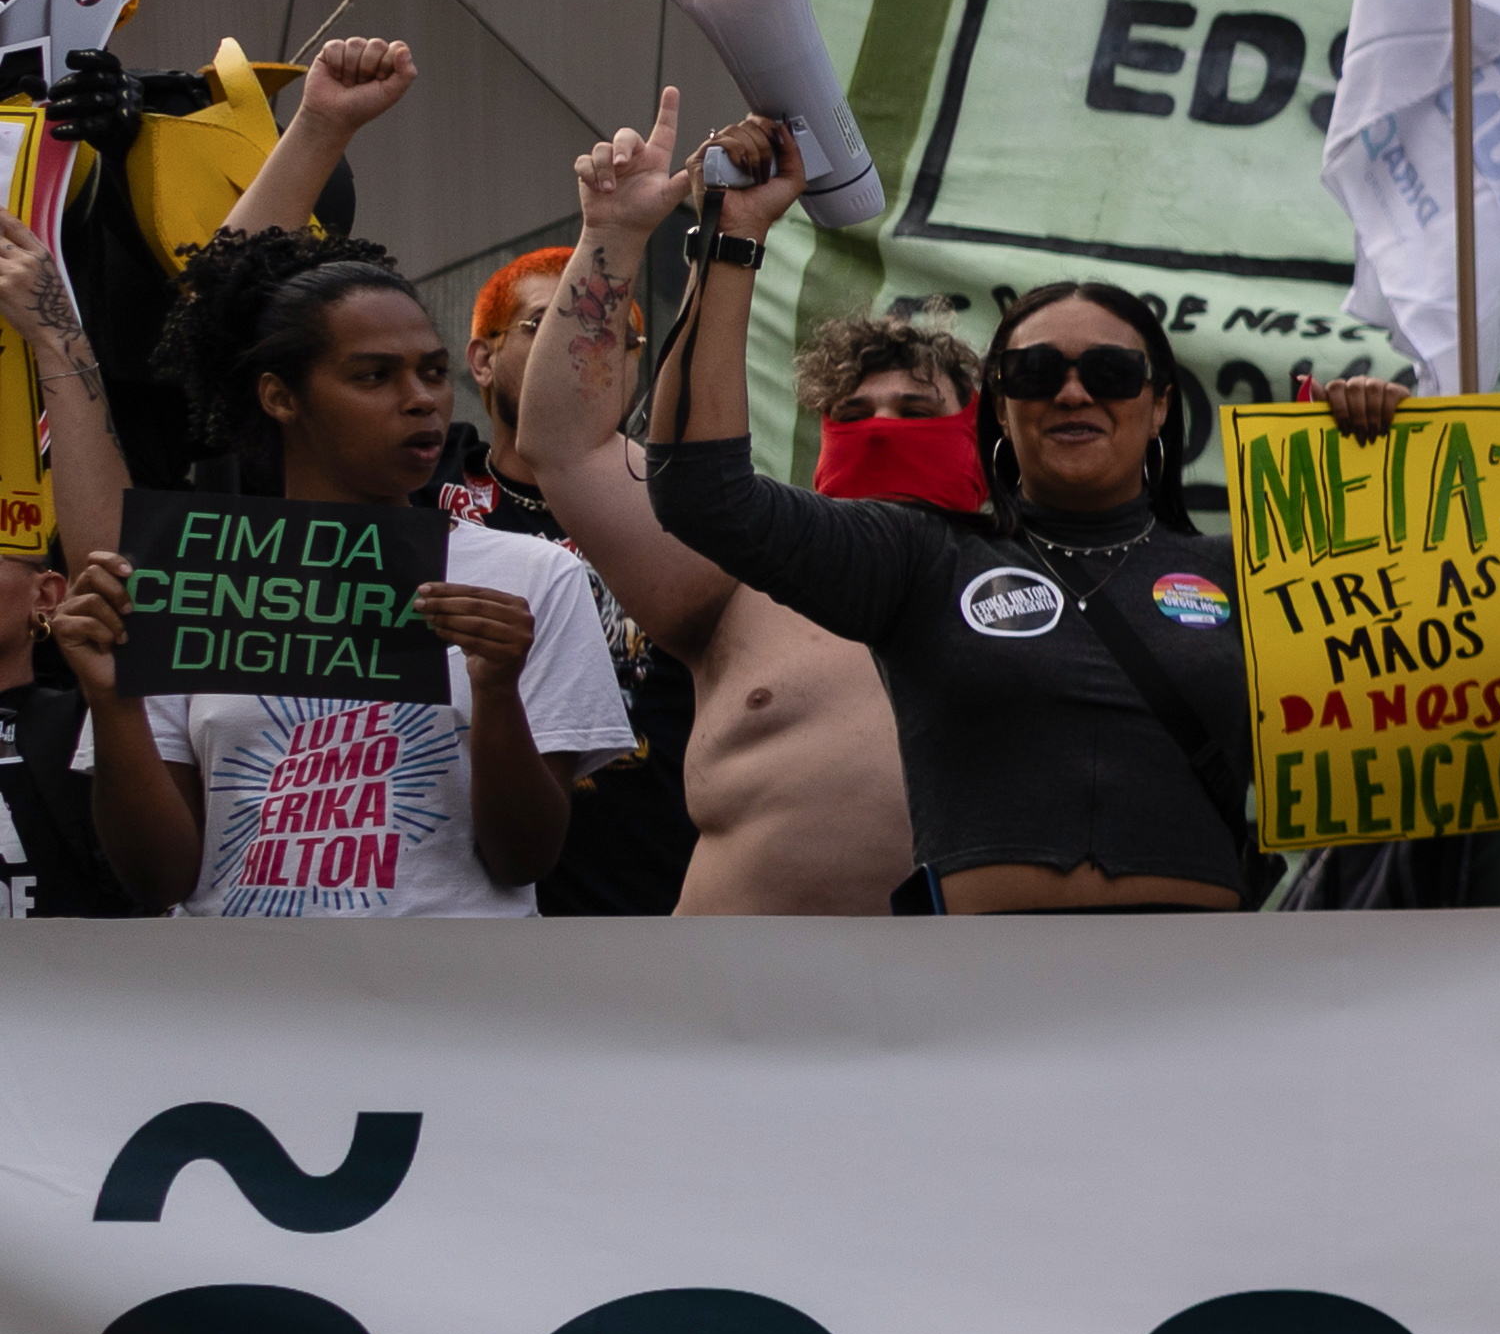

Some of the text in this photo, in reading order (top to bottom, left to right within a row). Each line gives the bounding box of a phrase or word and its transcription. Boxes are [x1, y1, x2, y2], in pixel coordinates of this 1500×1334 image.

[176, 511, 384, 571] FIM DA
[126, 568, 436, 630] CENSURA
[1263, 562, 1413, 635] TIRE
[171, 626, 401, 680] DIGITAL
[1323, 610, 1485, 684] MÃOS
[288, 700, 394, 757] LUTE
[1279, 689, 1353, 735] DA
[268, 734, 400, 794] COMO
[258, 779, 387, 837] ERIKA
[238, 832, 401, 890] HILTON
